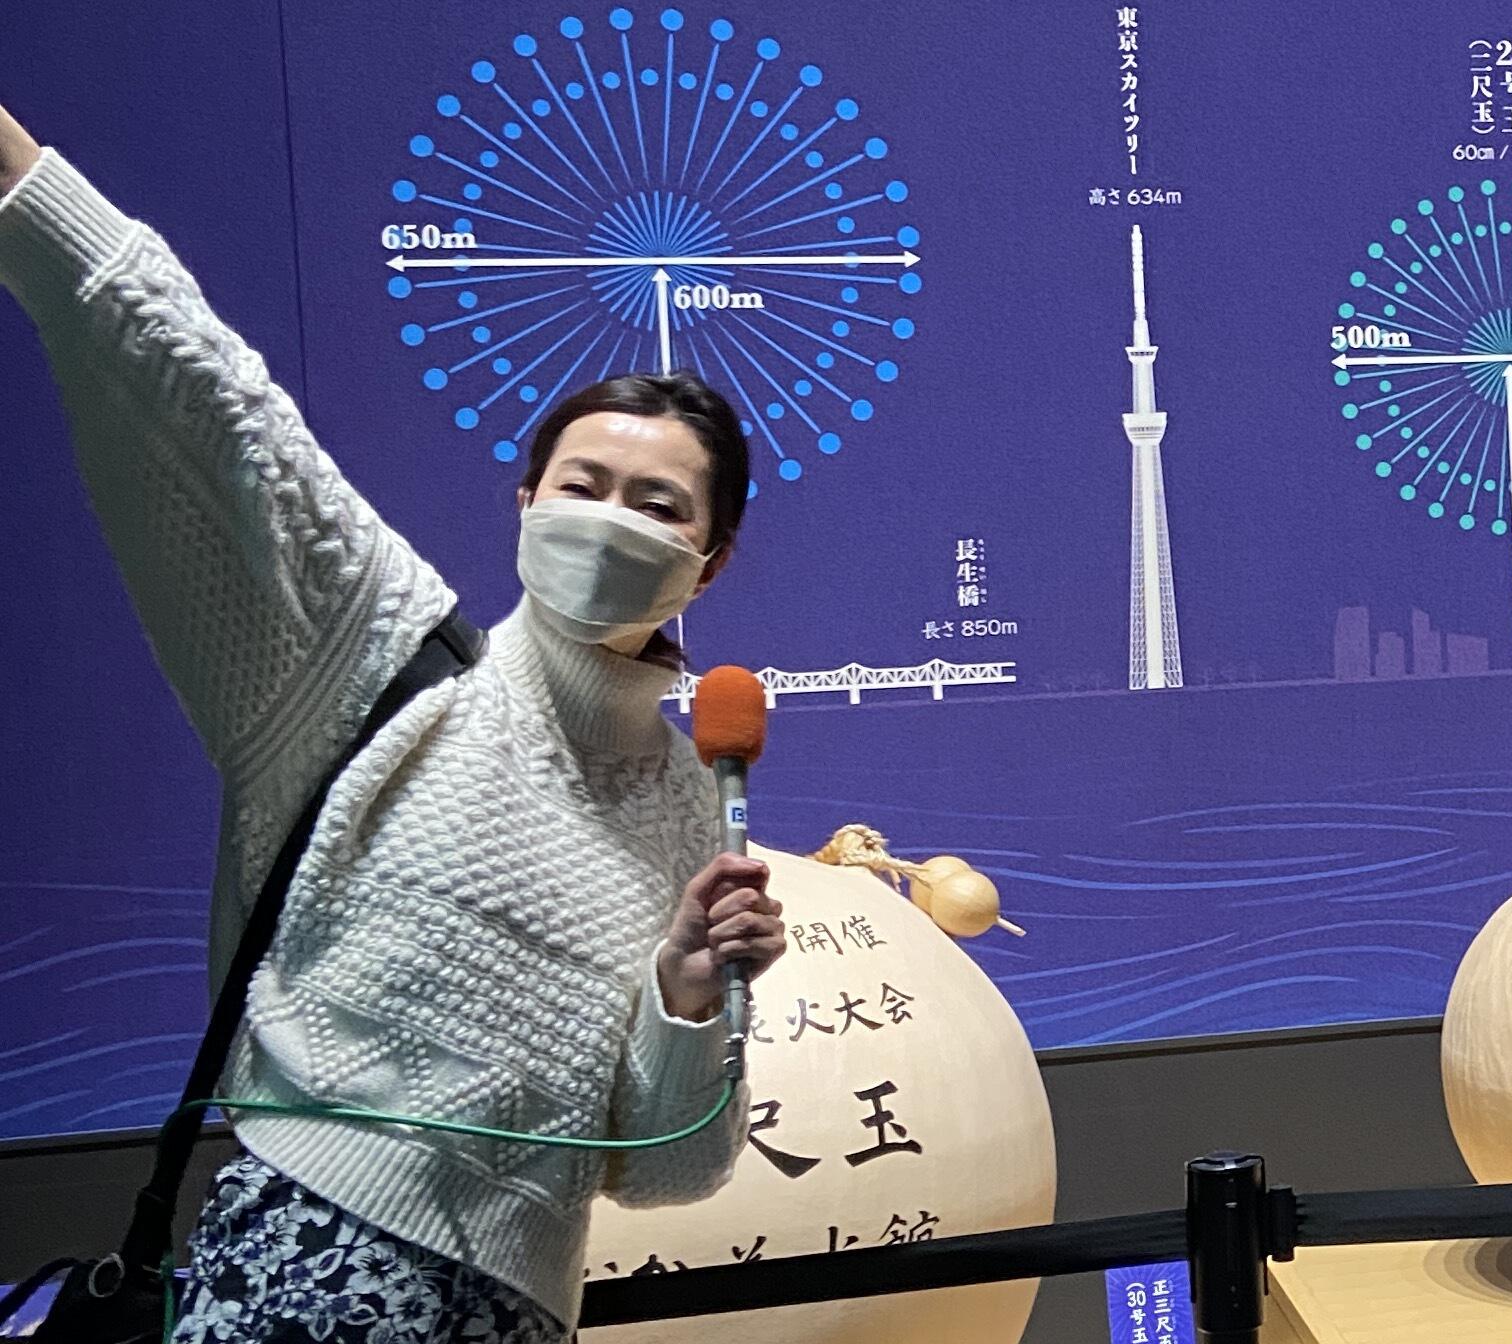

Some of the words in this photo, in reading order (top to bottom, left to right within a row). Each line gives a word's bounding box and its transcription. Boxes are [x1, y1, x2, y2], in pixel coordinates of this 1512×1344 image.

[1116, 6, 1140, 175] 東京スカイツリー
[1088, 187, 1121, 206] 高さ
[1126, 188, 1182, 205] 634m
[381, 224, 479, 250] 650m
[673, 285, 765, 310] 600m
[1330, 325, 1412, 350] 500m
[955, 538, 979, 607] 長生橋
[921, 620, 955, 640] 長さ
[960, 619, 1018, 637] 850m
